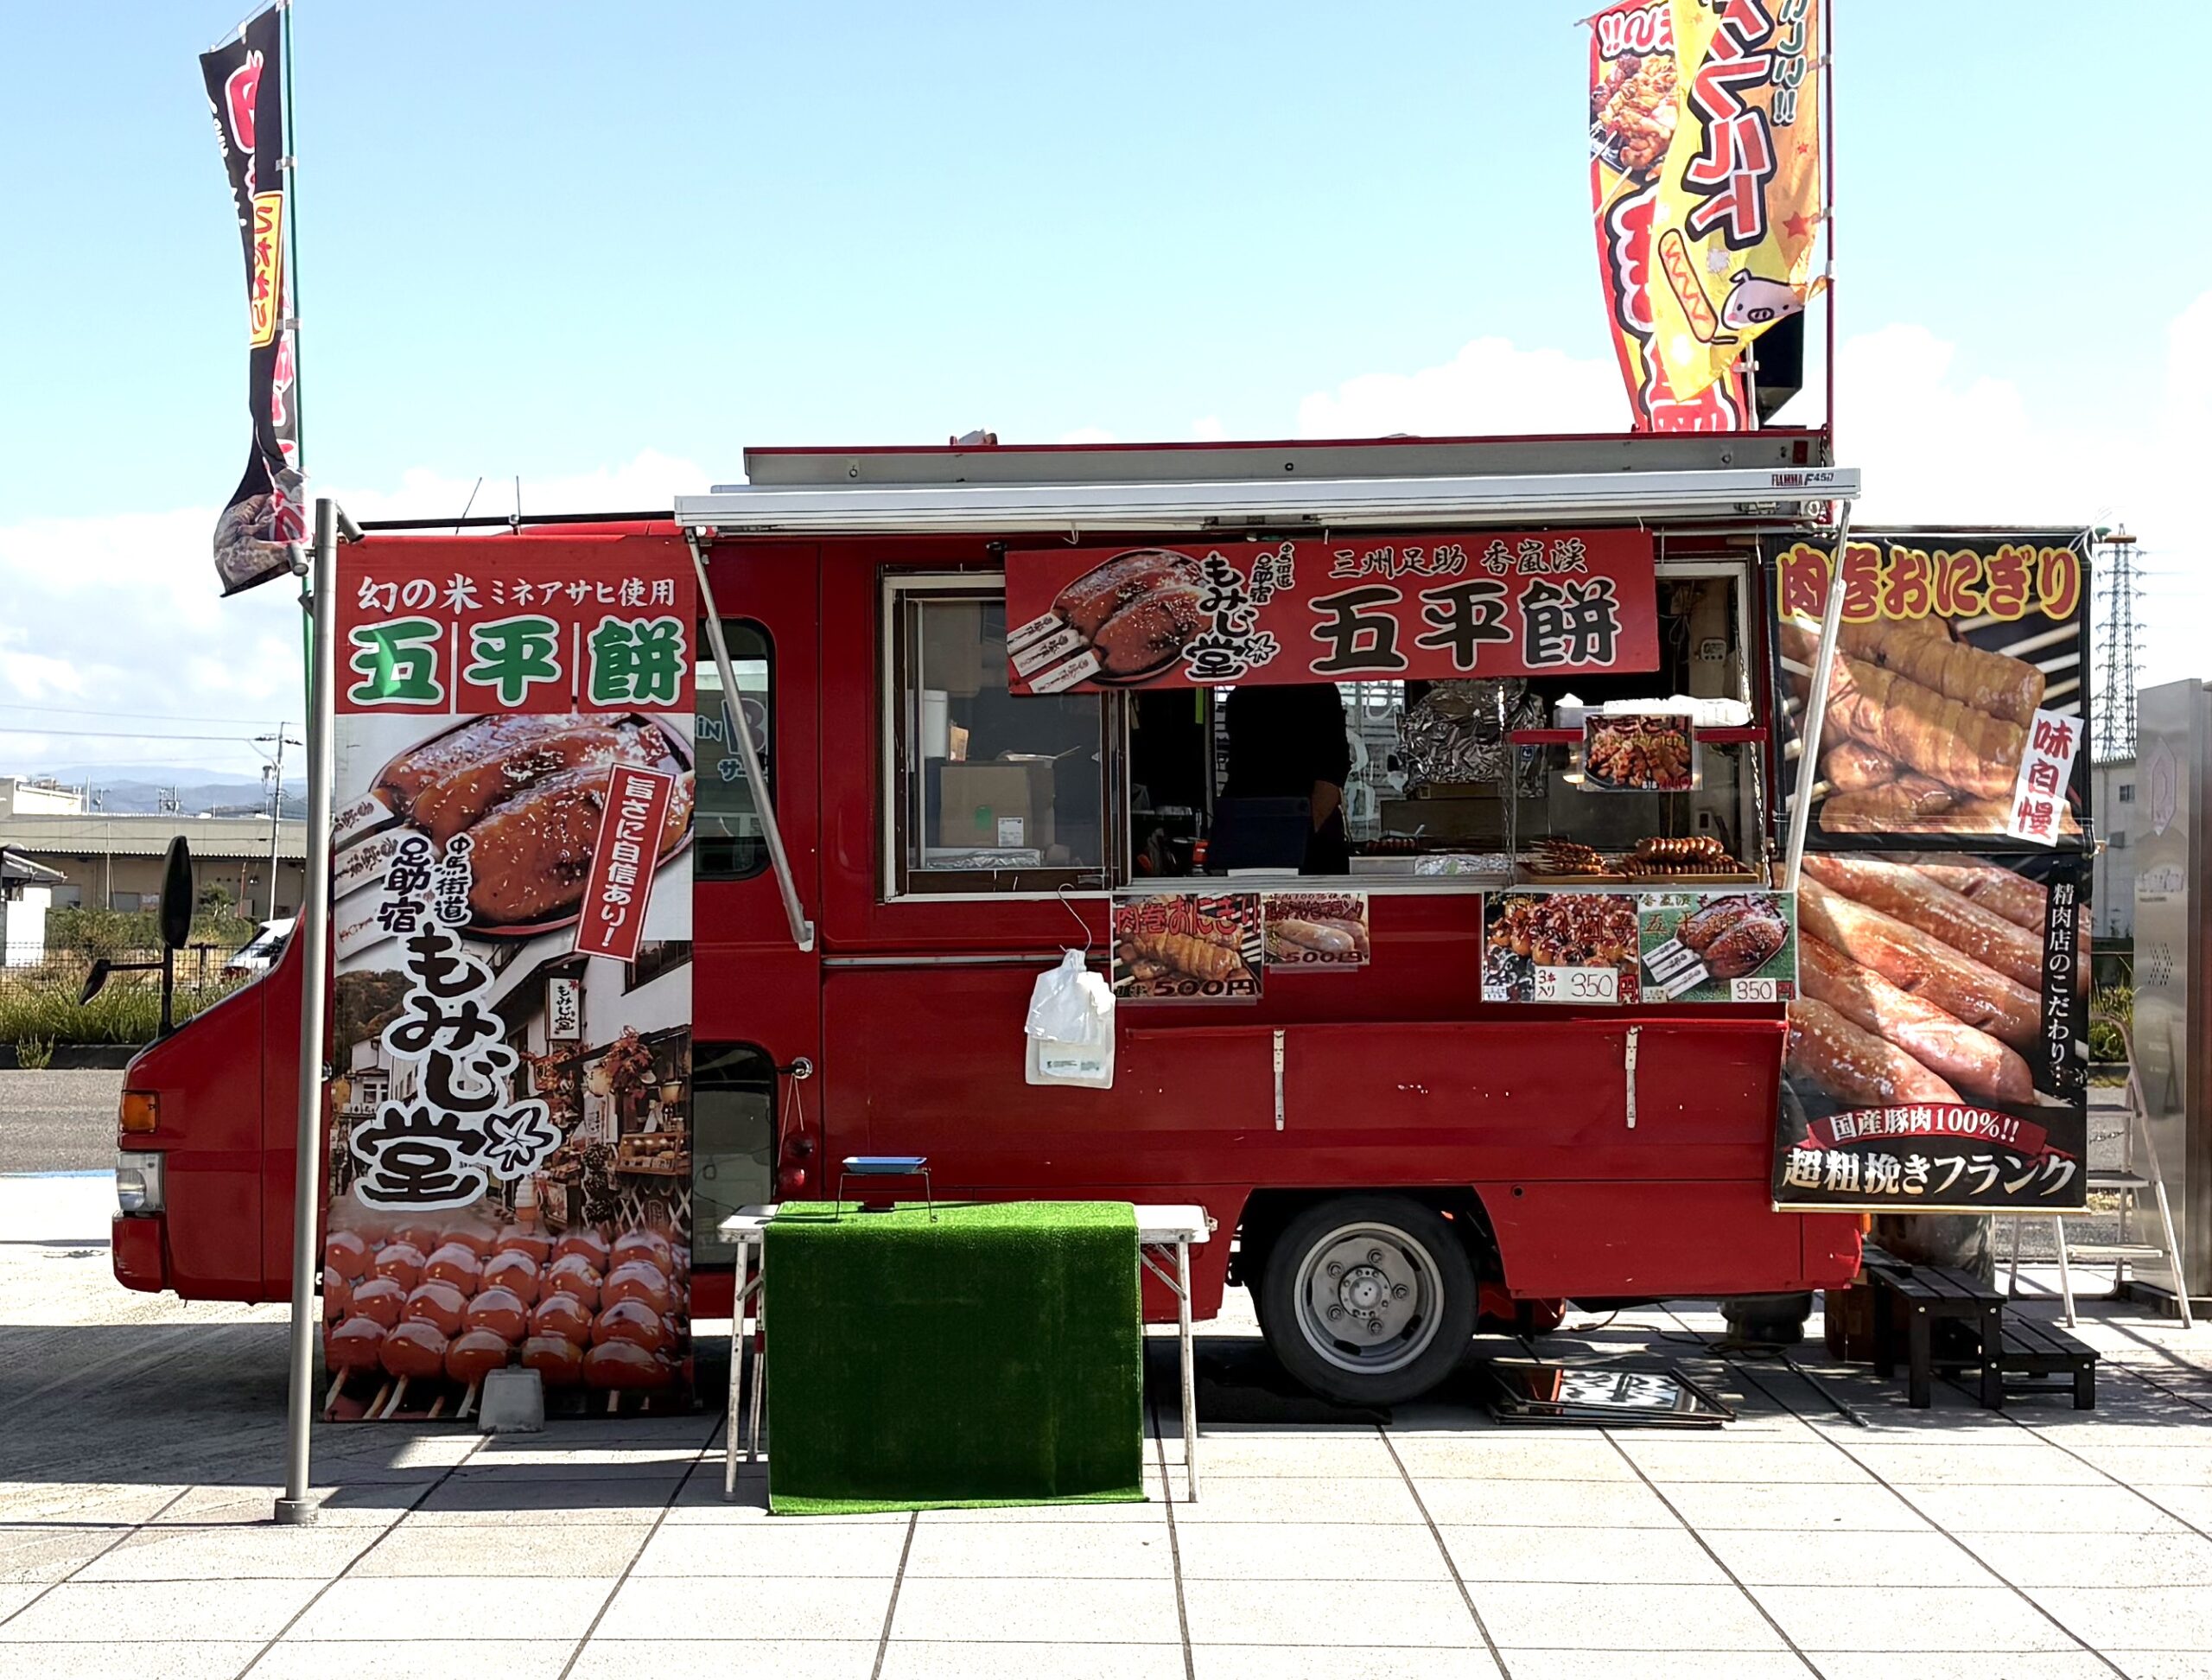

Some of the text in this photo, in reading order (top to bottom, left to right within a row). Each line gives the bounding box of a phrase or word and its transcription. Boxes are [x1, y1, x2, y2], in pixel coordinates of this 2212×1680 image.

[357, 574, 676, 614] 幻の米 ミネアサヒ使用
[1328, 538, 1587, 580] 三州足助 香嵐渓
[1777, 542, 2082, 623] 肉巻おにぎり
[1183, 551, 1258, 681] もみじ堂
[1308, 576, 1622, 675] 五平餅
[347, 615, 687, 706] 五平餅
[377, 836, 432, 933] 足助宿
[434, 832, 474, 927] 中馬街道
[1154, 978, 1256, 996] 500円
[1571, 972, 1613, 997] 350
[353, 921, 516, 1206] もみじ堂
[1829, 1107, 2020, 1142] 国産豚肉100%!!
[1781, 1146, 2077, 1197] 超粗挽きフランク
